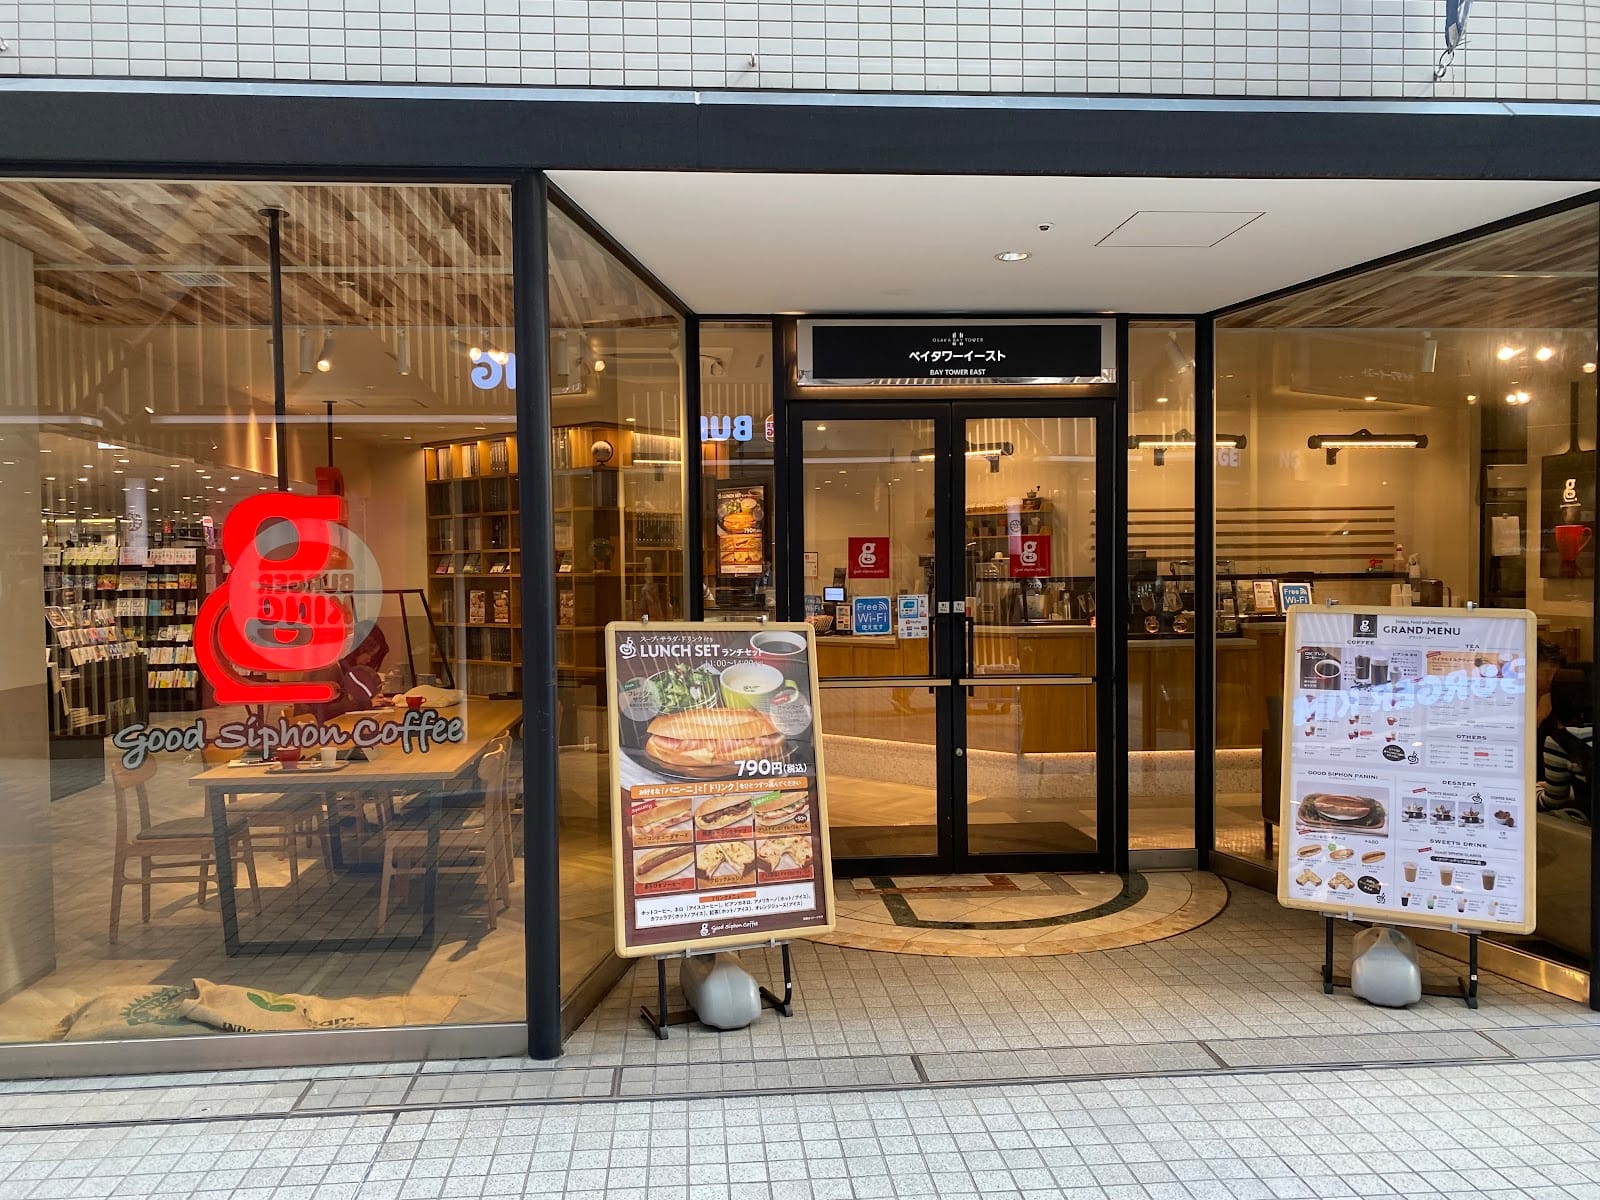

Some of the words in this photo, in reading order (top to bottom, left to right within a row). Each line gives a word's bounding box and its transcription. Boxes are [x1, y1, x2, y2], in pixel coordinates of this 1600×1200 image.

[909, 349, 1006, 362] ベイタワーイースト
[929, 368, 943, 376] BAY
[945, 368, 969, 376] TOWER
[969, 368, 986, 376] EAST
[1283, 587, 1299, 595] Free
[1285, 595, 1308, 604] Wi-Fi
[857, 602, 878, 611] Free
[857, 612, 887, 623] Wi-Fi
[1383, 625, 1424, 634] GRAND
[1426, 626, 1461, 636] MENU
[640, 645, 692, 658] LUNCH
[694, 644, 721, 657] SET
[721, 648, 763, 657] ランチセット
[113, 717, 205, 770] Good
[352, 708, 465, 754] Coffee
[1430, 838, 1461, 846] SWEETS
[1463, 841, 1488, 849] DRINK
